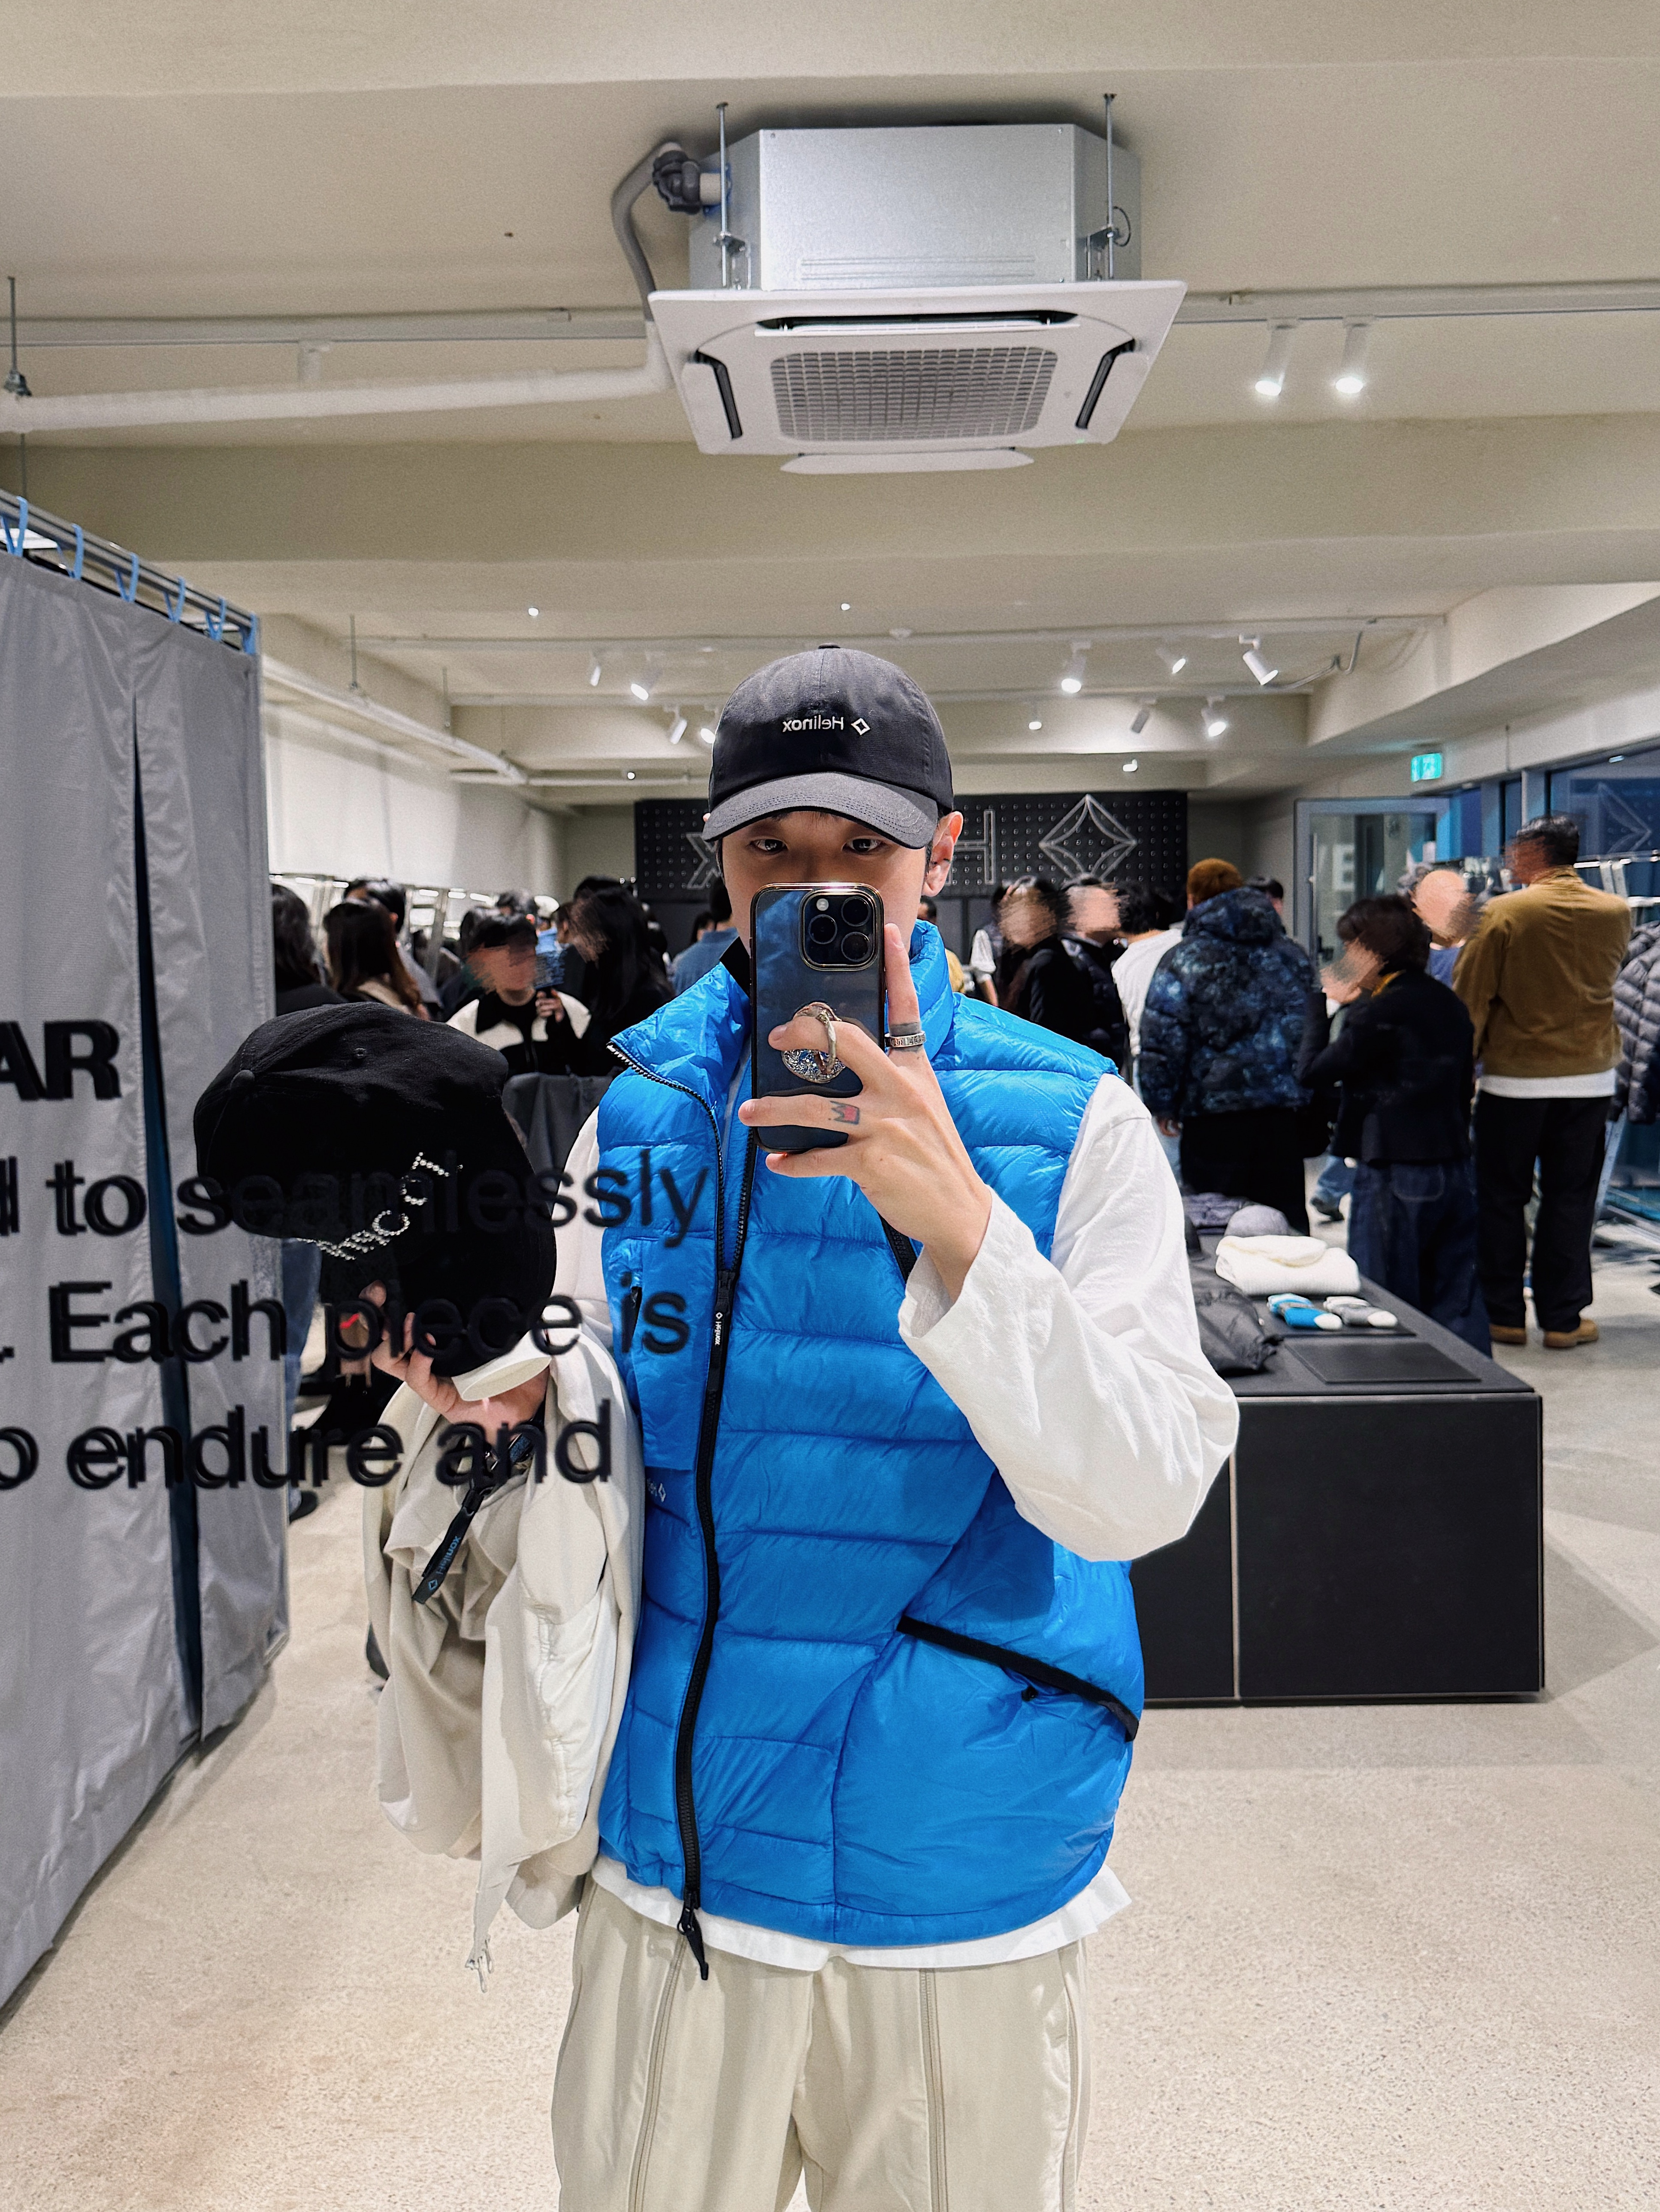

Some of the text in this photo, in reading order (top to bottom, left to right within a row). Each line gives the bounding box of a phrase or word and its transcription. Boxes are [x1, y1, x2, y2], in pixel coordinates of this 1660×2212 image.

[45, 1159, 146, 1237] to
[175, 1147, 709, 1248] seamlessly
[48, 1271, 691, 1382] Each piece is
[67, 1404, 404, 1489] endure
[435, 1397, 612, 1486] and
